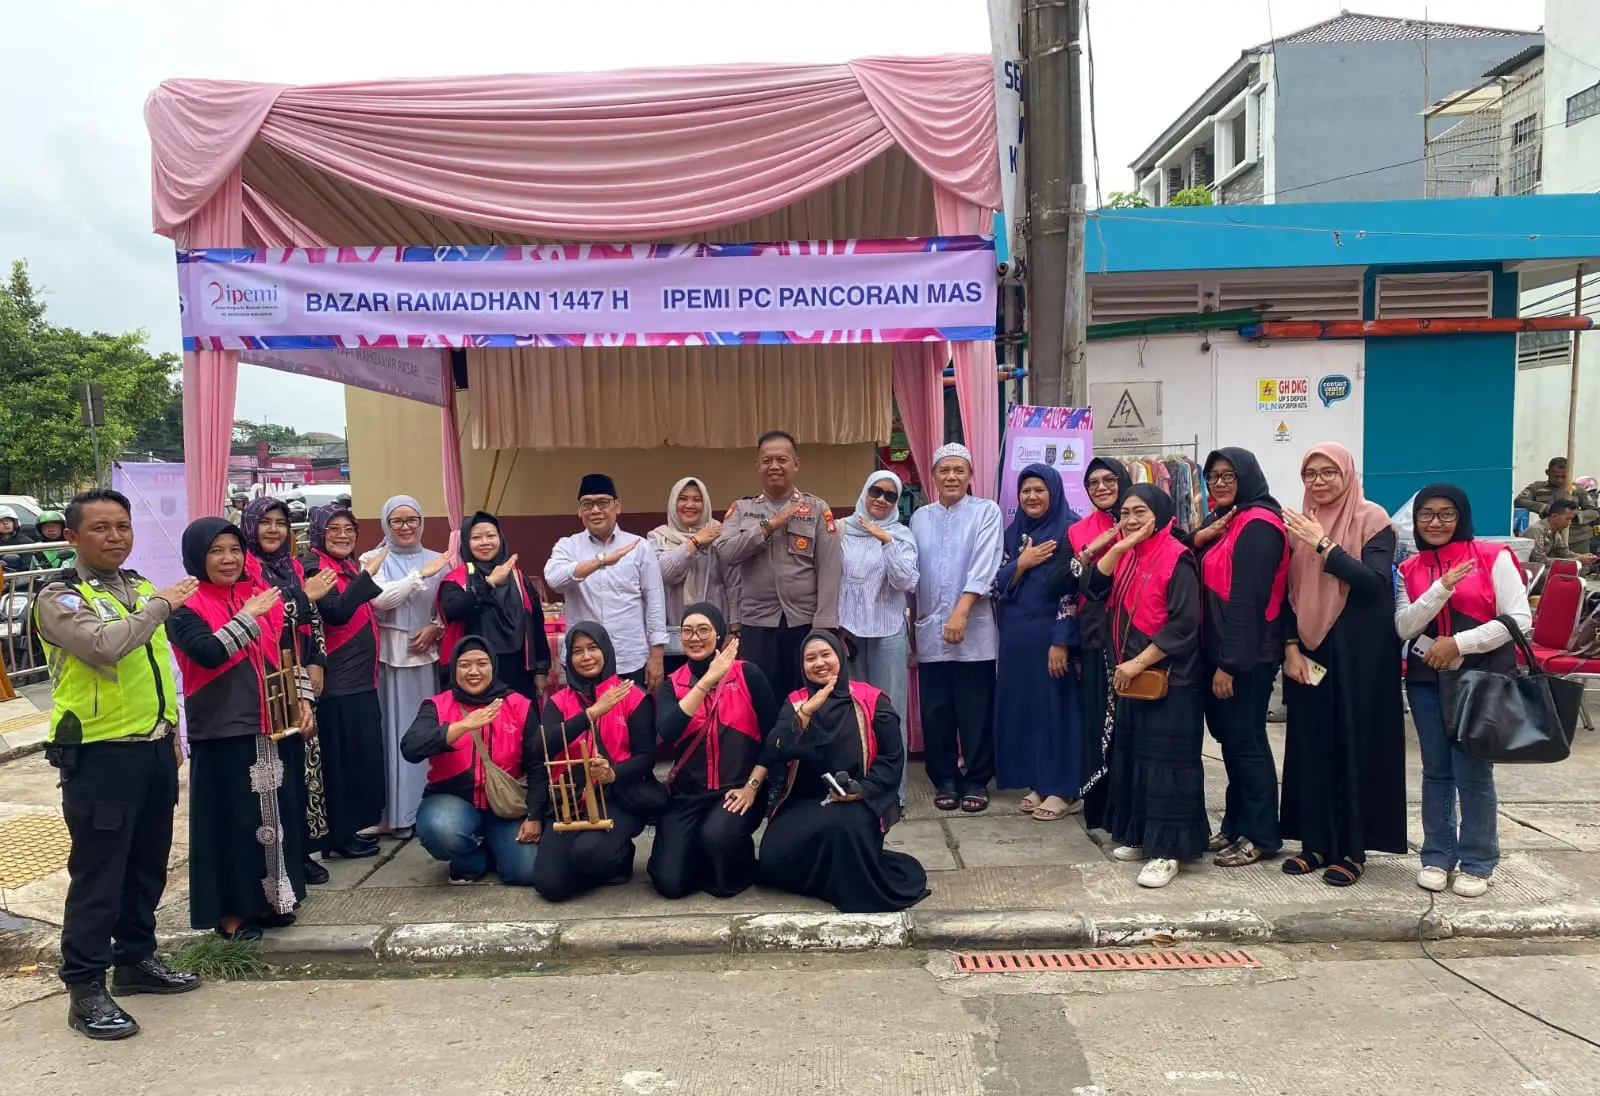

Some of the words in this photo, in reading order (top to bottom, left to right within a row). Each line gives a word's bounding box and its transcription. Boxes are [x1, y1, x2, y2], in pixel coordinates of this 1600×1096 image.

[226, 284, 278, 305] ipemi
[306, 293, 389, 312] BAZAR
[397, 291, 540, 311] RAMADHAN
[549, 291, 604, 310] 1447
[612, 290, 628, 309] H
[663, 289, 730, 309] IPEMI
[738, 288, 771, 308] PC
[779, 284, 919, 307] PANCORAN
[927, 282, 982, 303] MAS
[1279, 380, 1289, 394] GH
[1291, 380, 1307, 394] DKG
